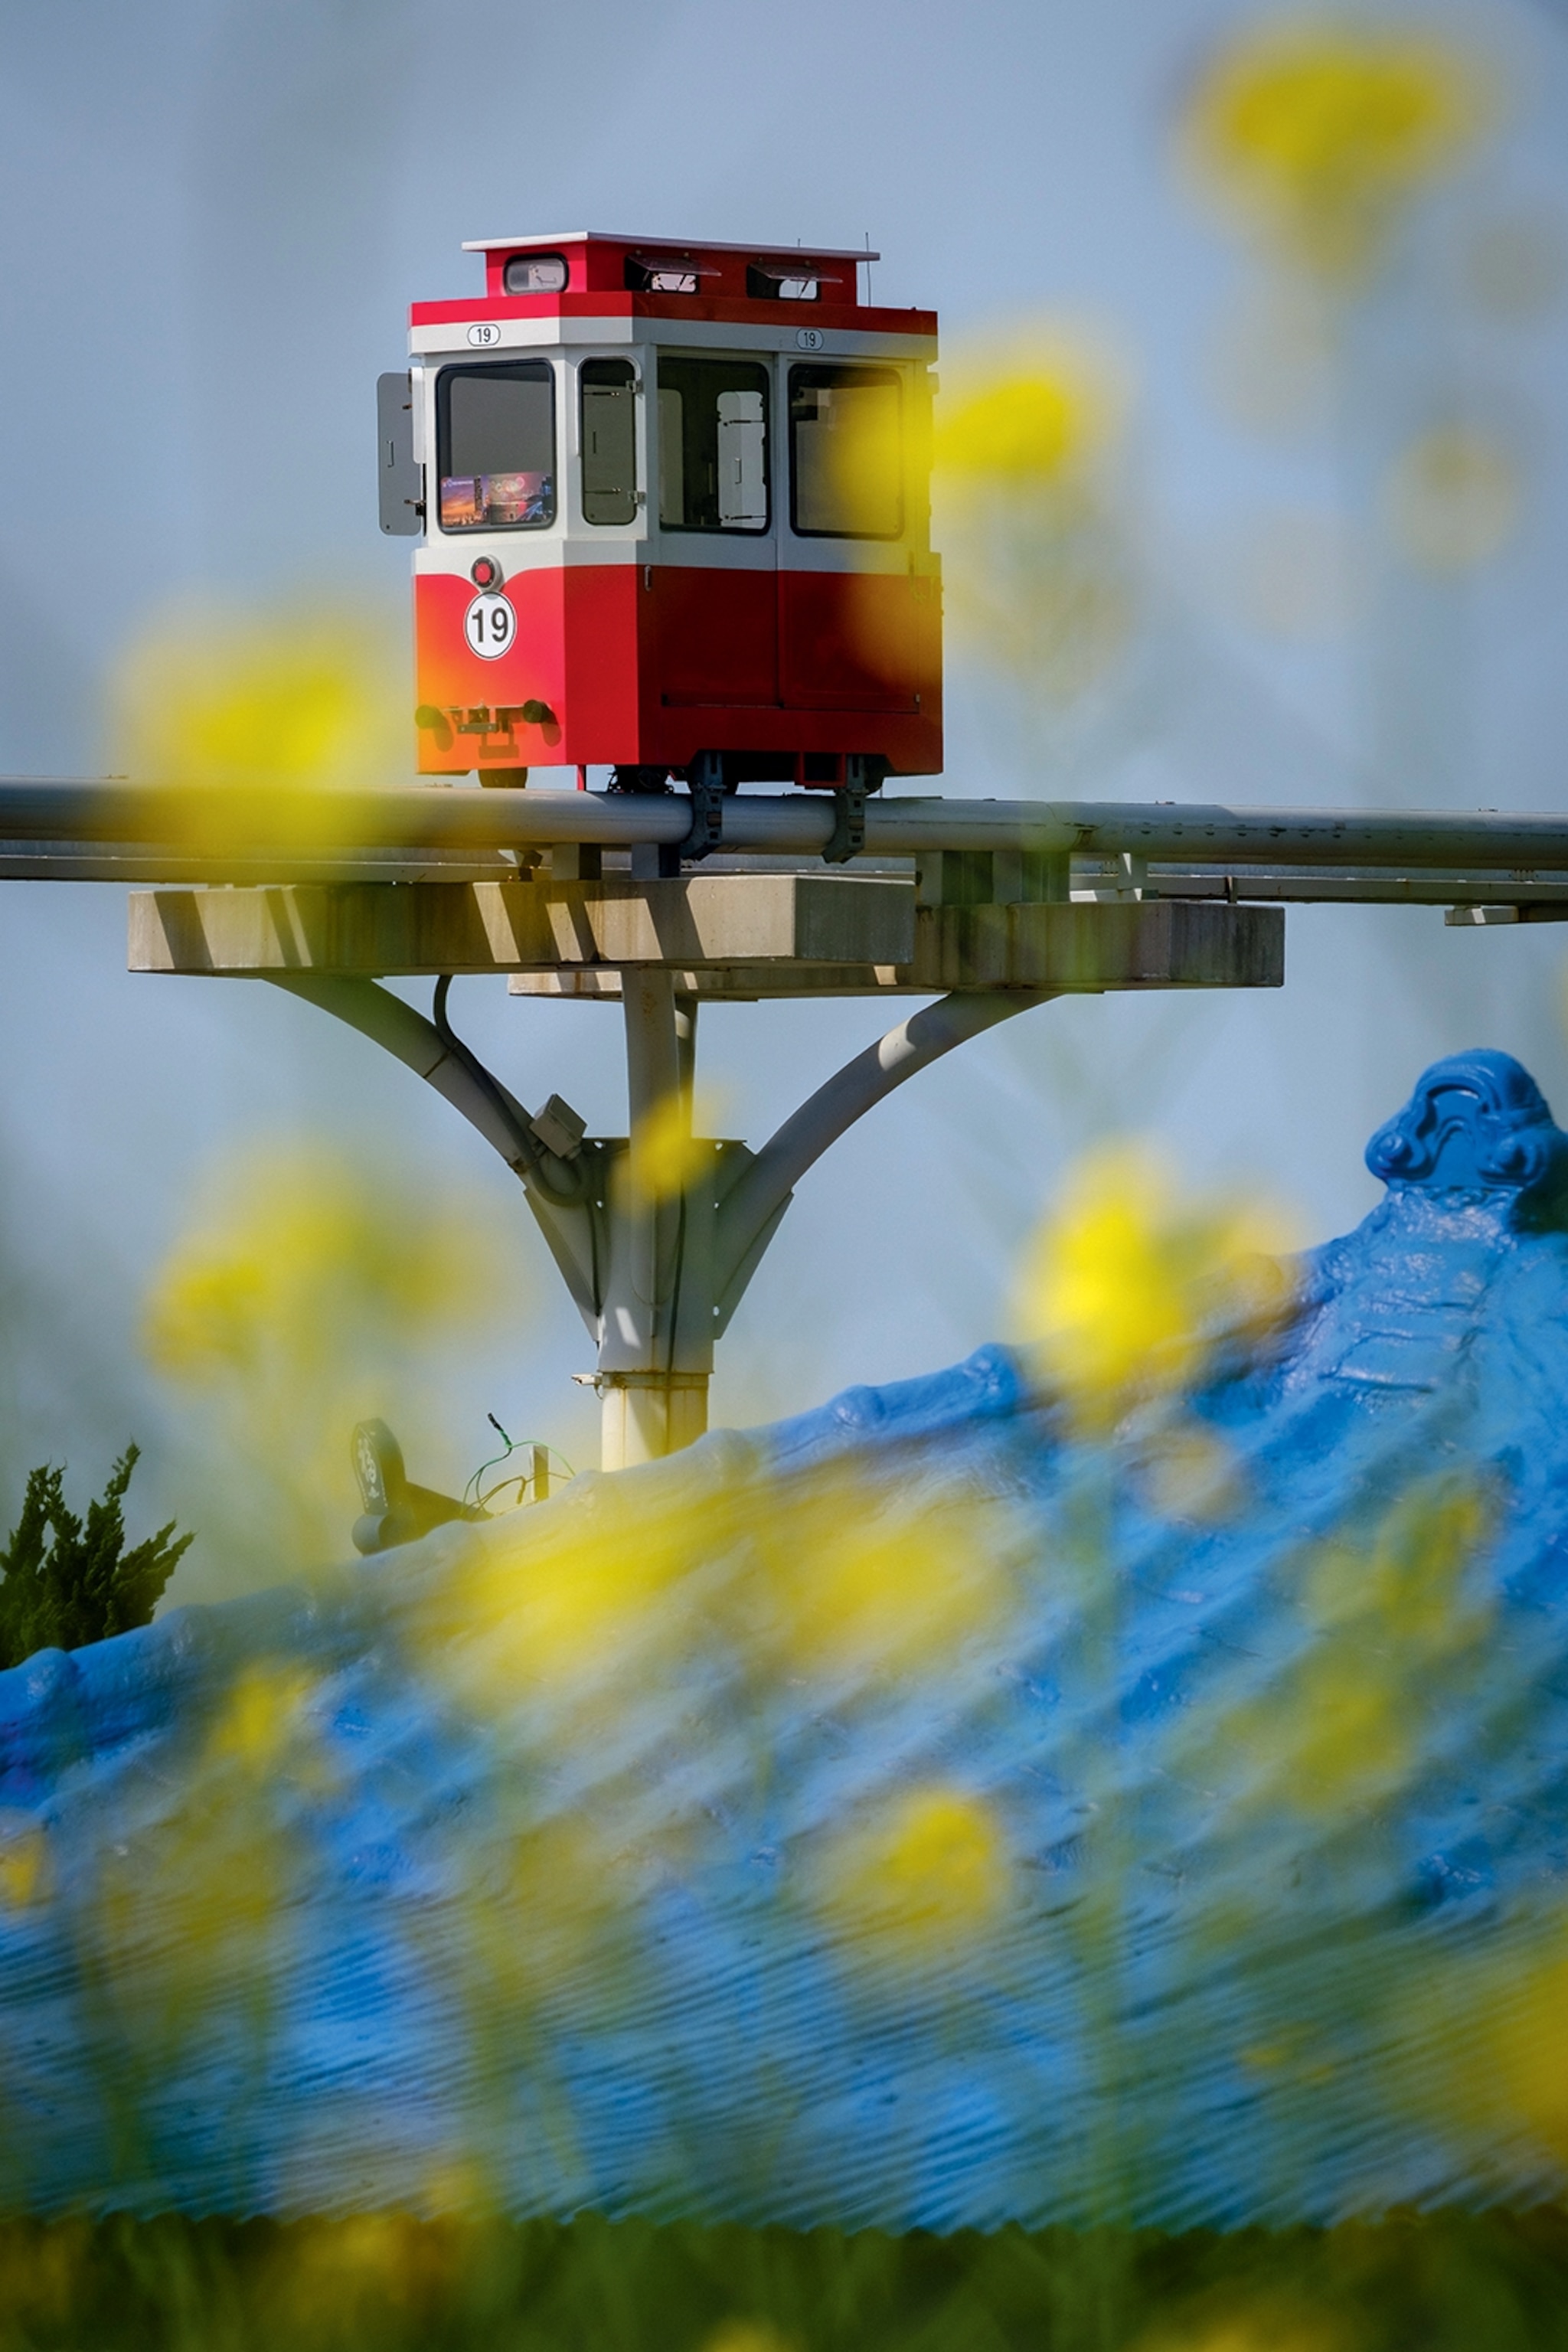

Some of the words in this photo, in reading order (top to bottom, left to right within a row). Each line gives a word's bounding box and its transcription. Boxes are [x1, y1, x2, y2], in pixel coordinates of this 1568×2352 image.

[477, 328, 491, 343] 19
[804, 332, 815, 347] 19
[472, 607, 508, 642] 19
